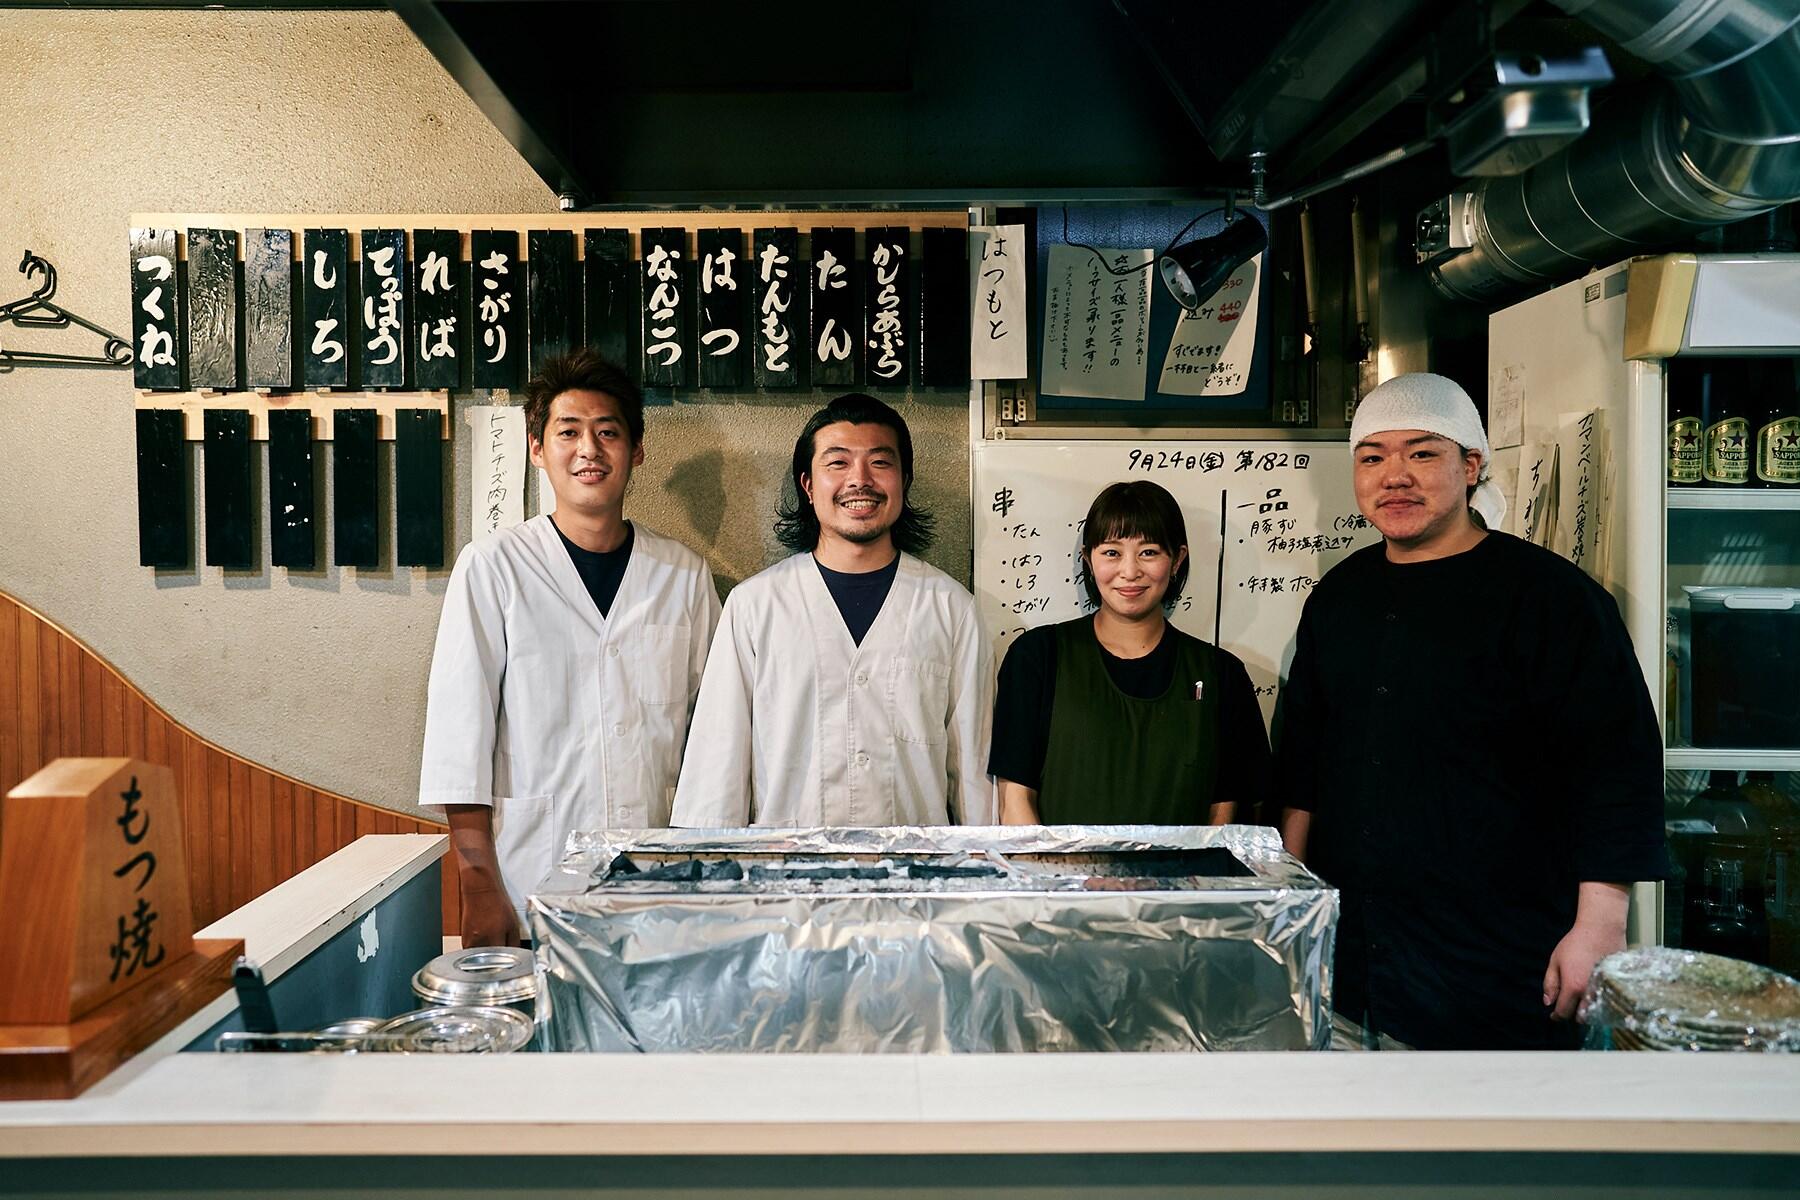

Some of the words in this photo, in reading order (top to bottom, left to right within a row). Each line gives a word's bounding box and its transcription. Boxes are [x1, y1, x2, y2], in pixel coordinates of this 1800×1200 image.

[137, 255, 176, 368] つくね
[312, 251, 343, 363] しろ
[364, 246, 402, 365] てっぽう
[420, 251, 456, 361] れば
[479, 251, 510, 363] さがり
[646, 244, 682, 366] なんこつ
[702, 248, 739, 356] はつ
[760, 244, 790, 372] たんもと
[816, 251, 852, 362] たん
[869, 243, 904, 378] かしらあぶら
[982, 238, 1008, 340] はつもと
[1219, 300, 1241, 312] 440
[1205, 373, 1241, 387] どうぞ!
[992, 486, 1015, 518] 串
[1128, 449, 1224, 473] 9月24日(金)
[1234, 449, 1310, 473] 第182回
[1237, 488, 1289, 514] 一品
[1012, 523, 1041, 539] たん
[1012, 554, 1042, 569] はつ
[1016, 574, 1037, 591] しろ
[1267, 534, 1354, 555] 柚子塩煮込み
[1012, 597, 1050, 614] さがり
[110, 775, 166, 983] もつ焼
